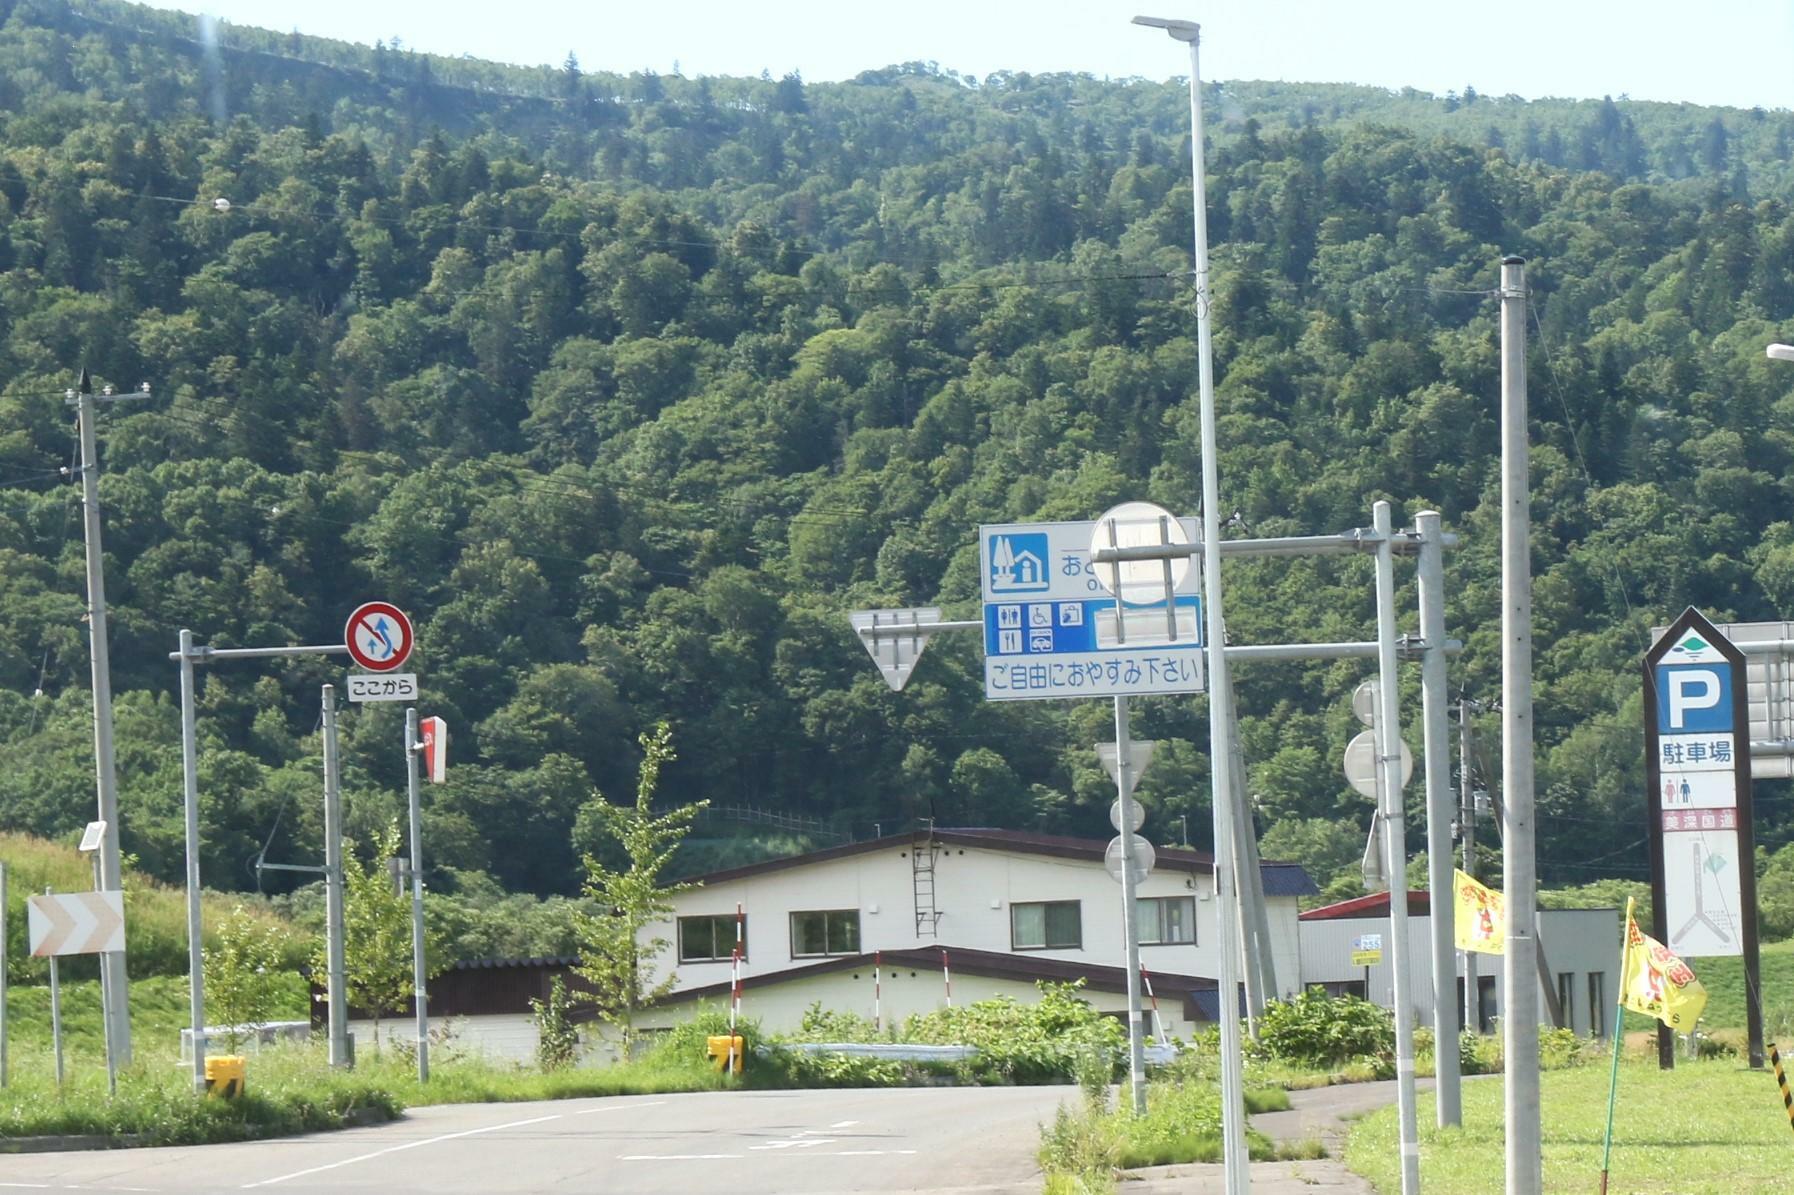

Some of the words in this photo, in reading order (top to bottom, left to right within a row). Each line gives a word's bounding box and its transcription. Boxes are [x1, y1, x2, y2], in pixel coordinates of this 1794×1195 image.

[992, 657, 1198, 690] ご自由におやすみ下さい
[353, 680, 412, 696] ここから
[1668, 670, 1721, 729] P
[1662, 741, 1731, 765] 駐車場
